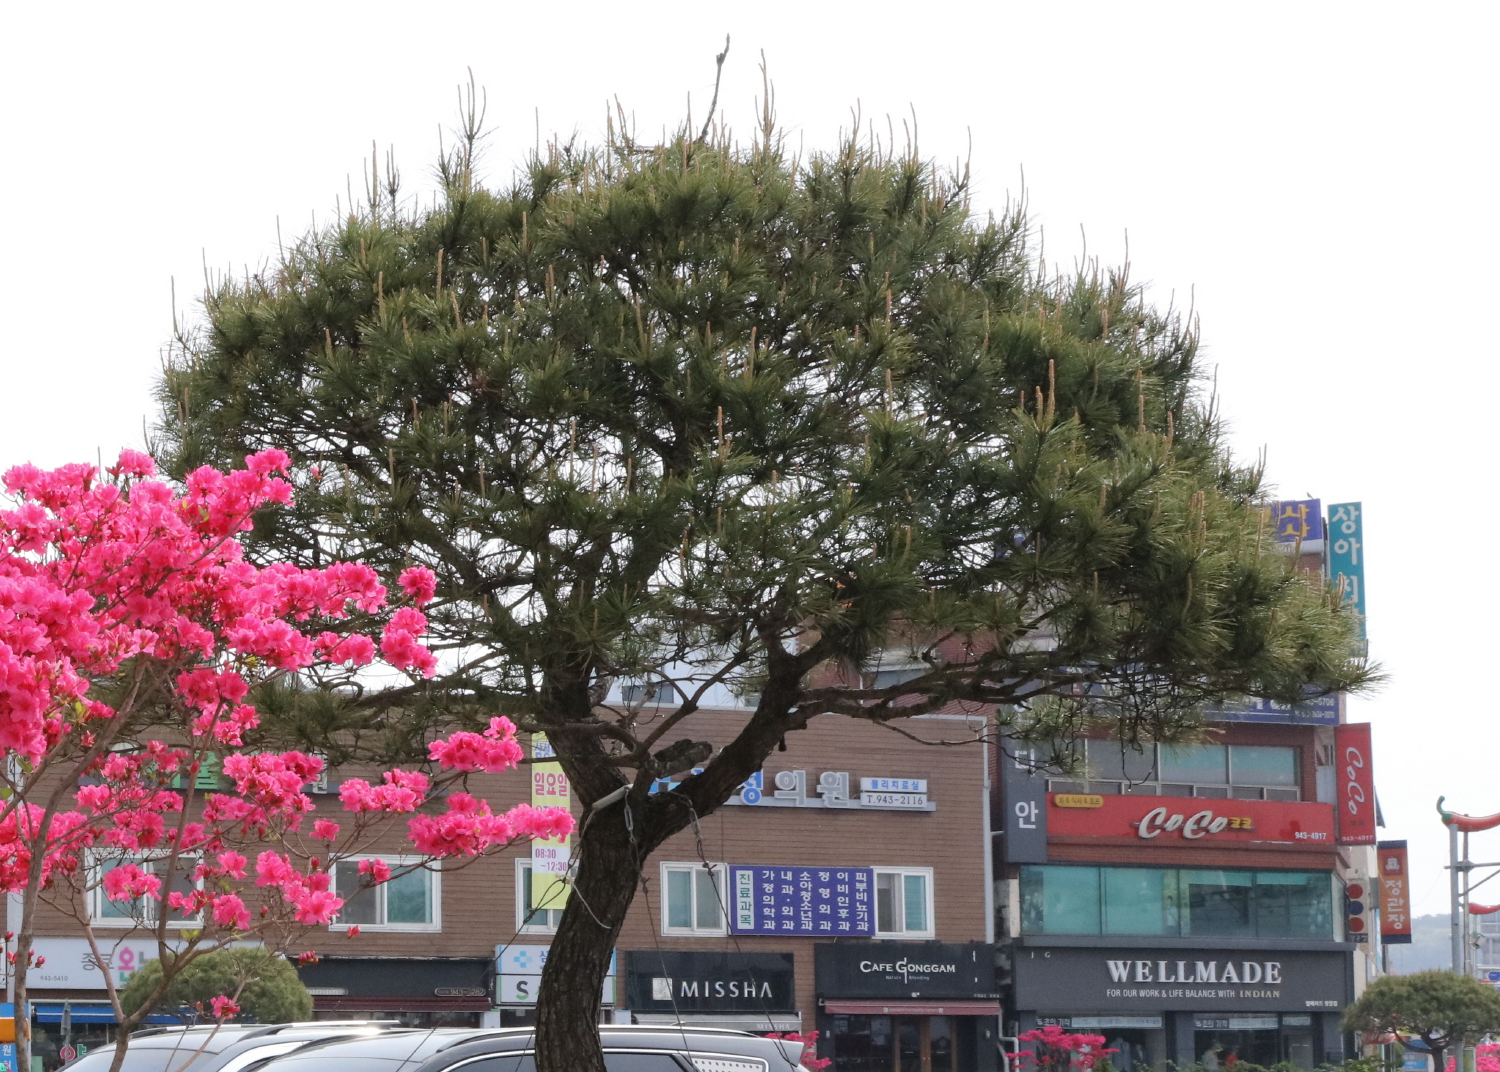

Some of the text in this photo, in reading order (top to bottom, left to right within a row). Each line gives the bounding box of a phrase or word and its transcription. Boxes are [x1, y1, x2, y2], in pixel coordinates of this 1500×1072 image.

[533, 772, 569, 797] 일요일
[866, 794, 924, 806] T.943-2116
[1294, 831, 1328, 841] 943-4917
[534, 848, 557, 859] 08:30
[739, 873, 752, 926] 진료과목
[762, 870, 776, 930] 가정의학과
[799, 871, 814, 931] 소아청소년과
[818, 871, 832, 931] 정형외과
[836, 872, 851, 932] 이비인후과
[855, 872, 870, 932] 피부비뇨기과
[860, 958, 956, 975] CAFE GONGGAM
[1105, 960, 1282, 983] WELLMADE
[680, 980, 773, 998] MISSHA
[1106, 988, 1280, 998] FOR OUR WORK & LIFE BALANCE WITH INDIAN
